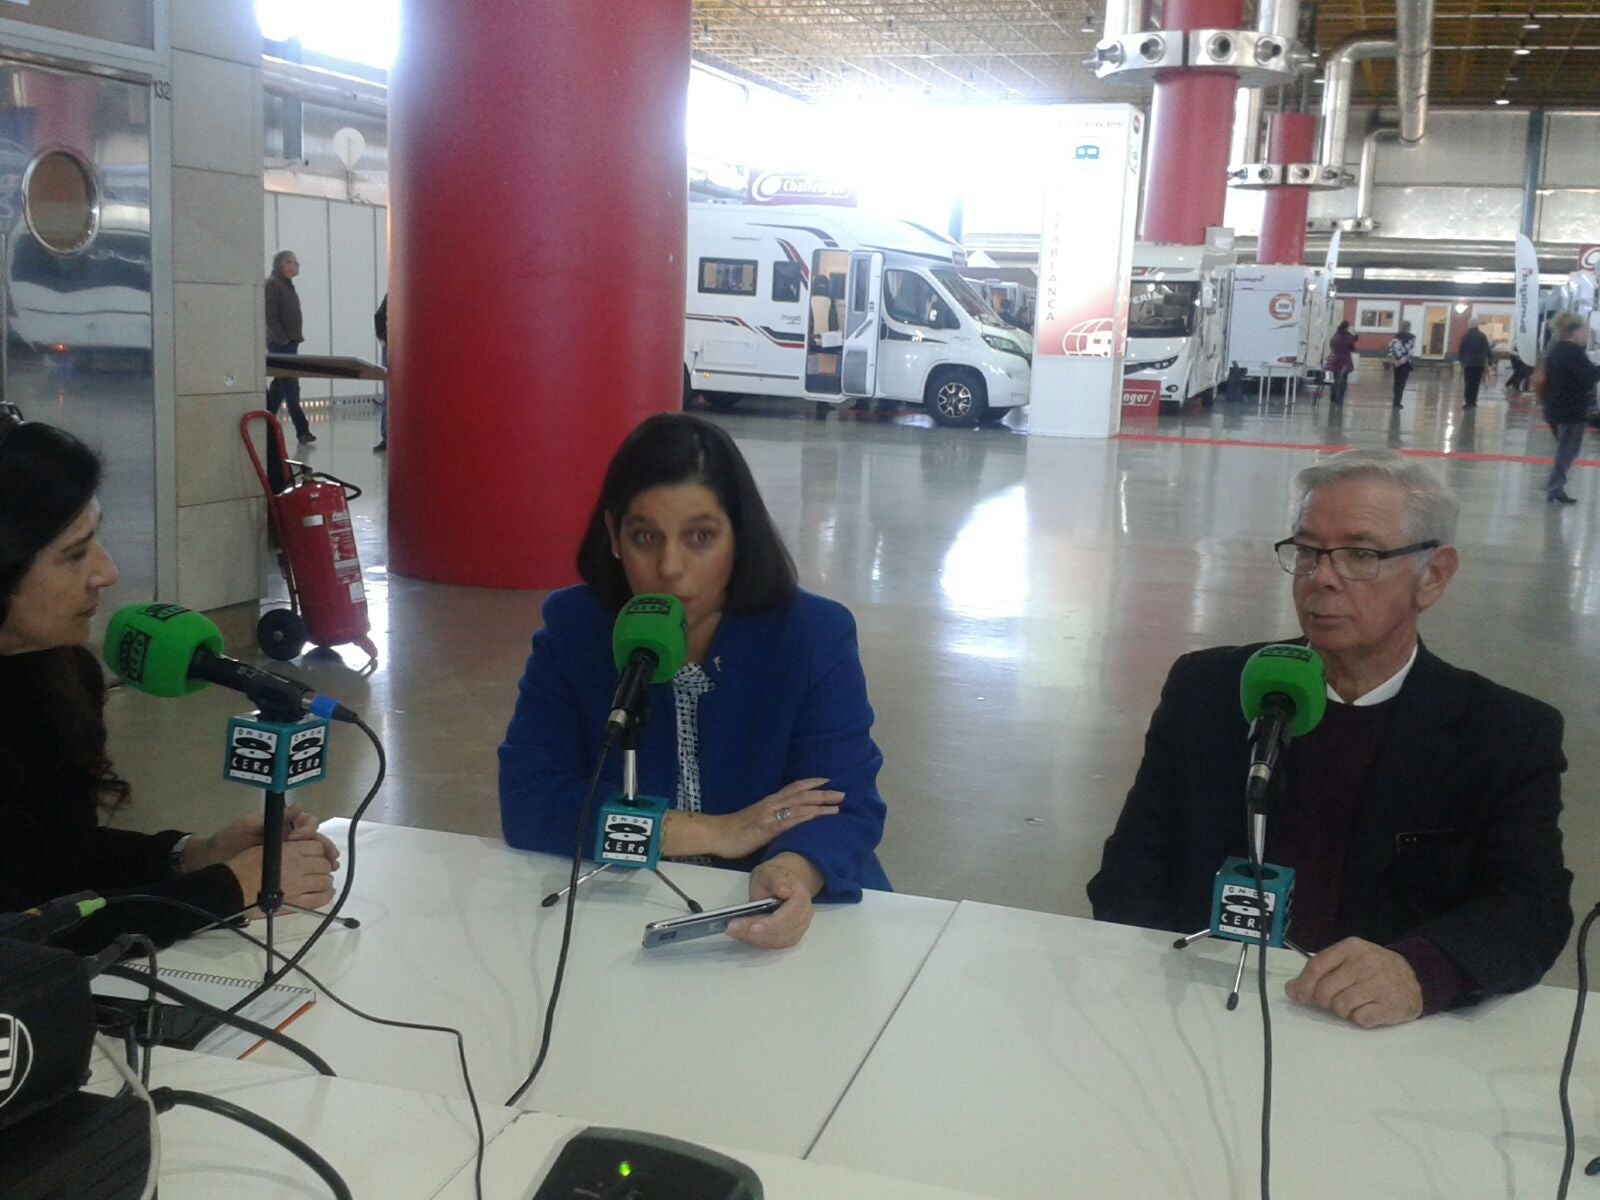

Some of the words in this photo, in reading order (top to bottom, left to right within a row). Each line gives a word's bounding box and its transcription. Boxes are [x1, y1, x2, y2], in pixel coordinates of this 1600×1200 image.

[238, 728, 273, 741] ONDA
[294, 729, 321, 742] ONDA
[232, 757, 270, 773] CERO
[288, 758, 320, 774] CERO
[611, 815, 648, 825] ONDA
[604, 841, 644, 853] CERO
[1221, 913, 1262, 929] CER
